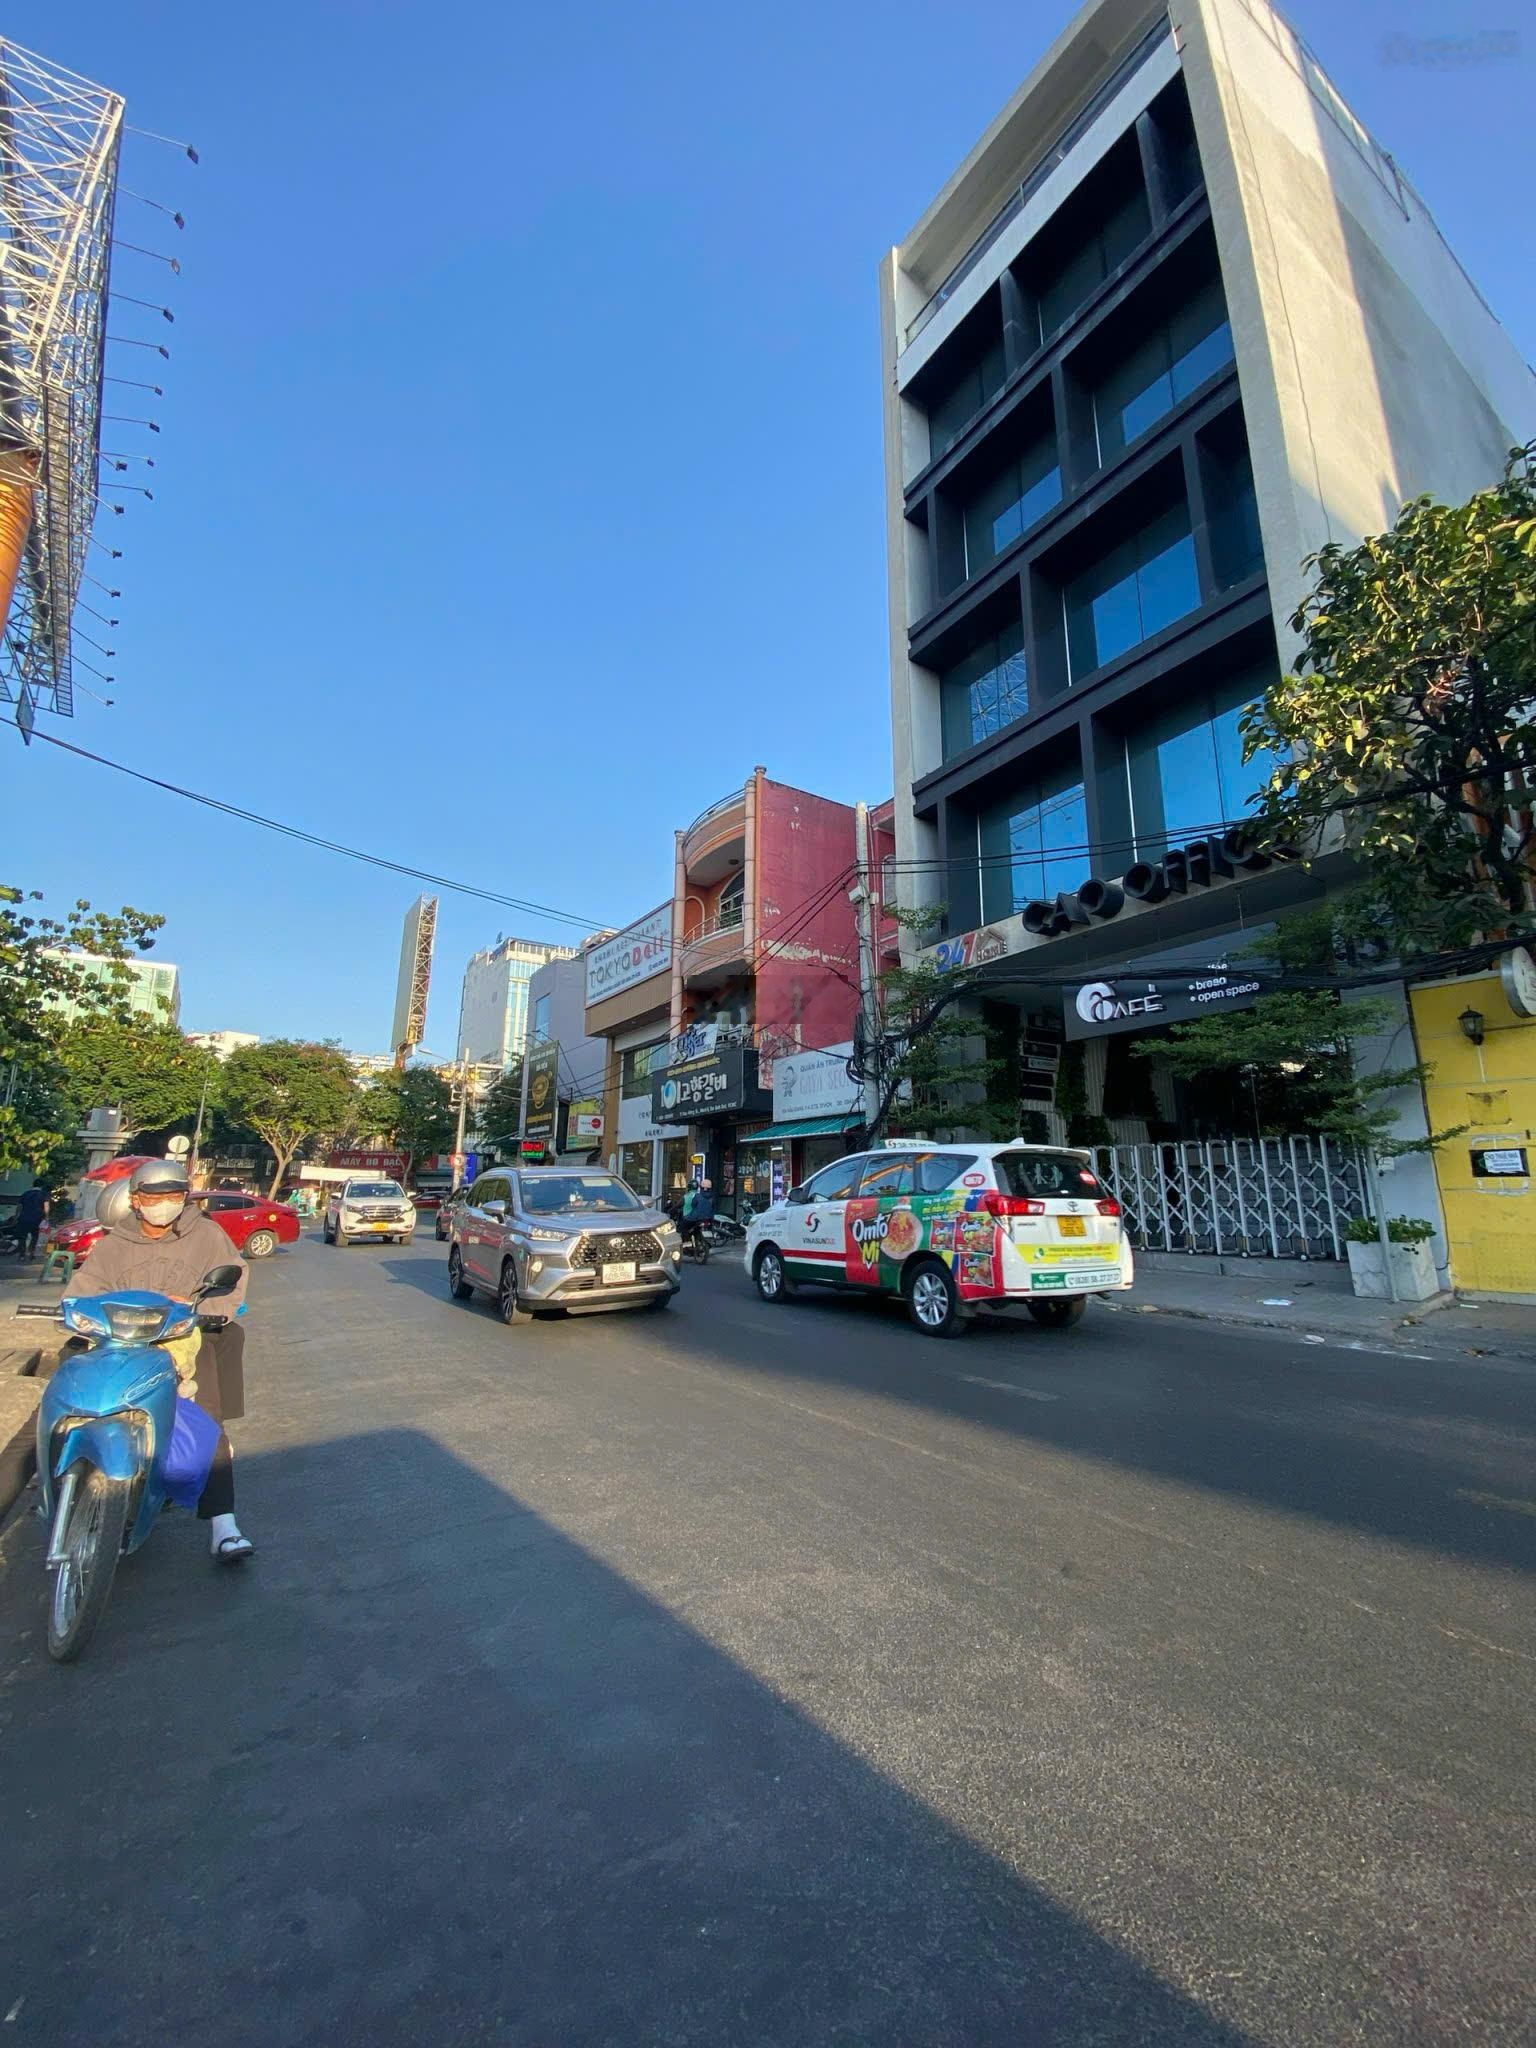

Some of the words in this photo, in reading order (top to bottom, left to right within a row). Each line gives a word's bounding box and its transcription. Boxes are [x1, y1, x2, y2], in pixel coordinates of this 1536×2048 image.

[588, 951, 631, 989] TOKYO
[1197, 989, 1225, 1002] open
[1225, 981, 1260, 997] space
